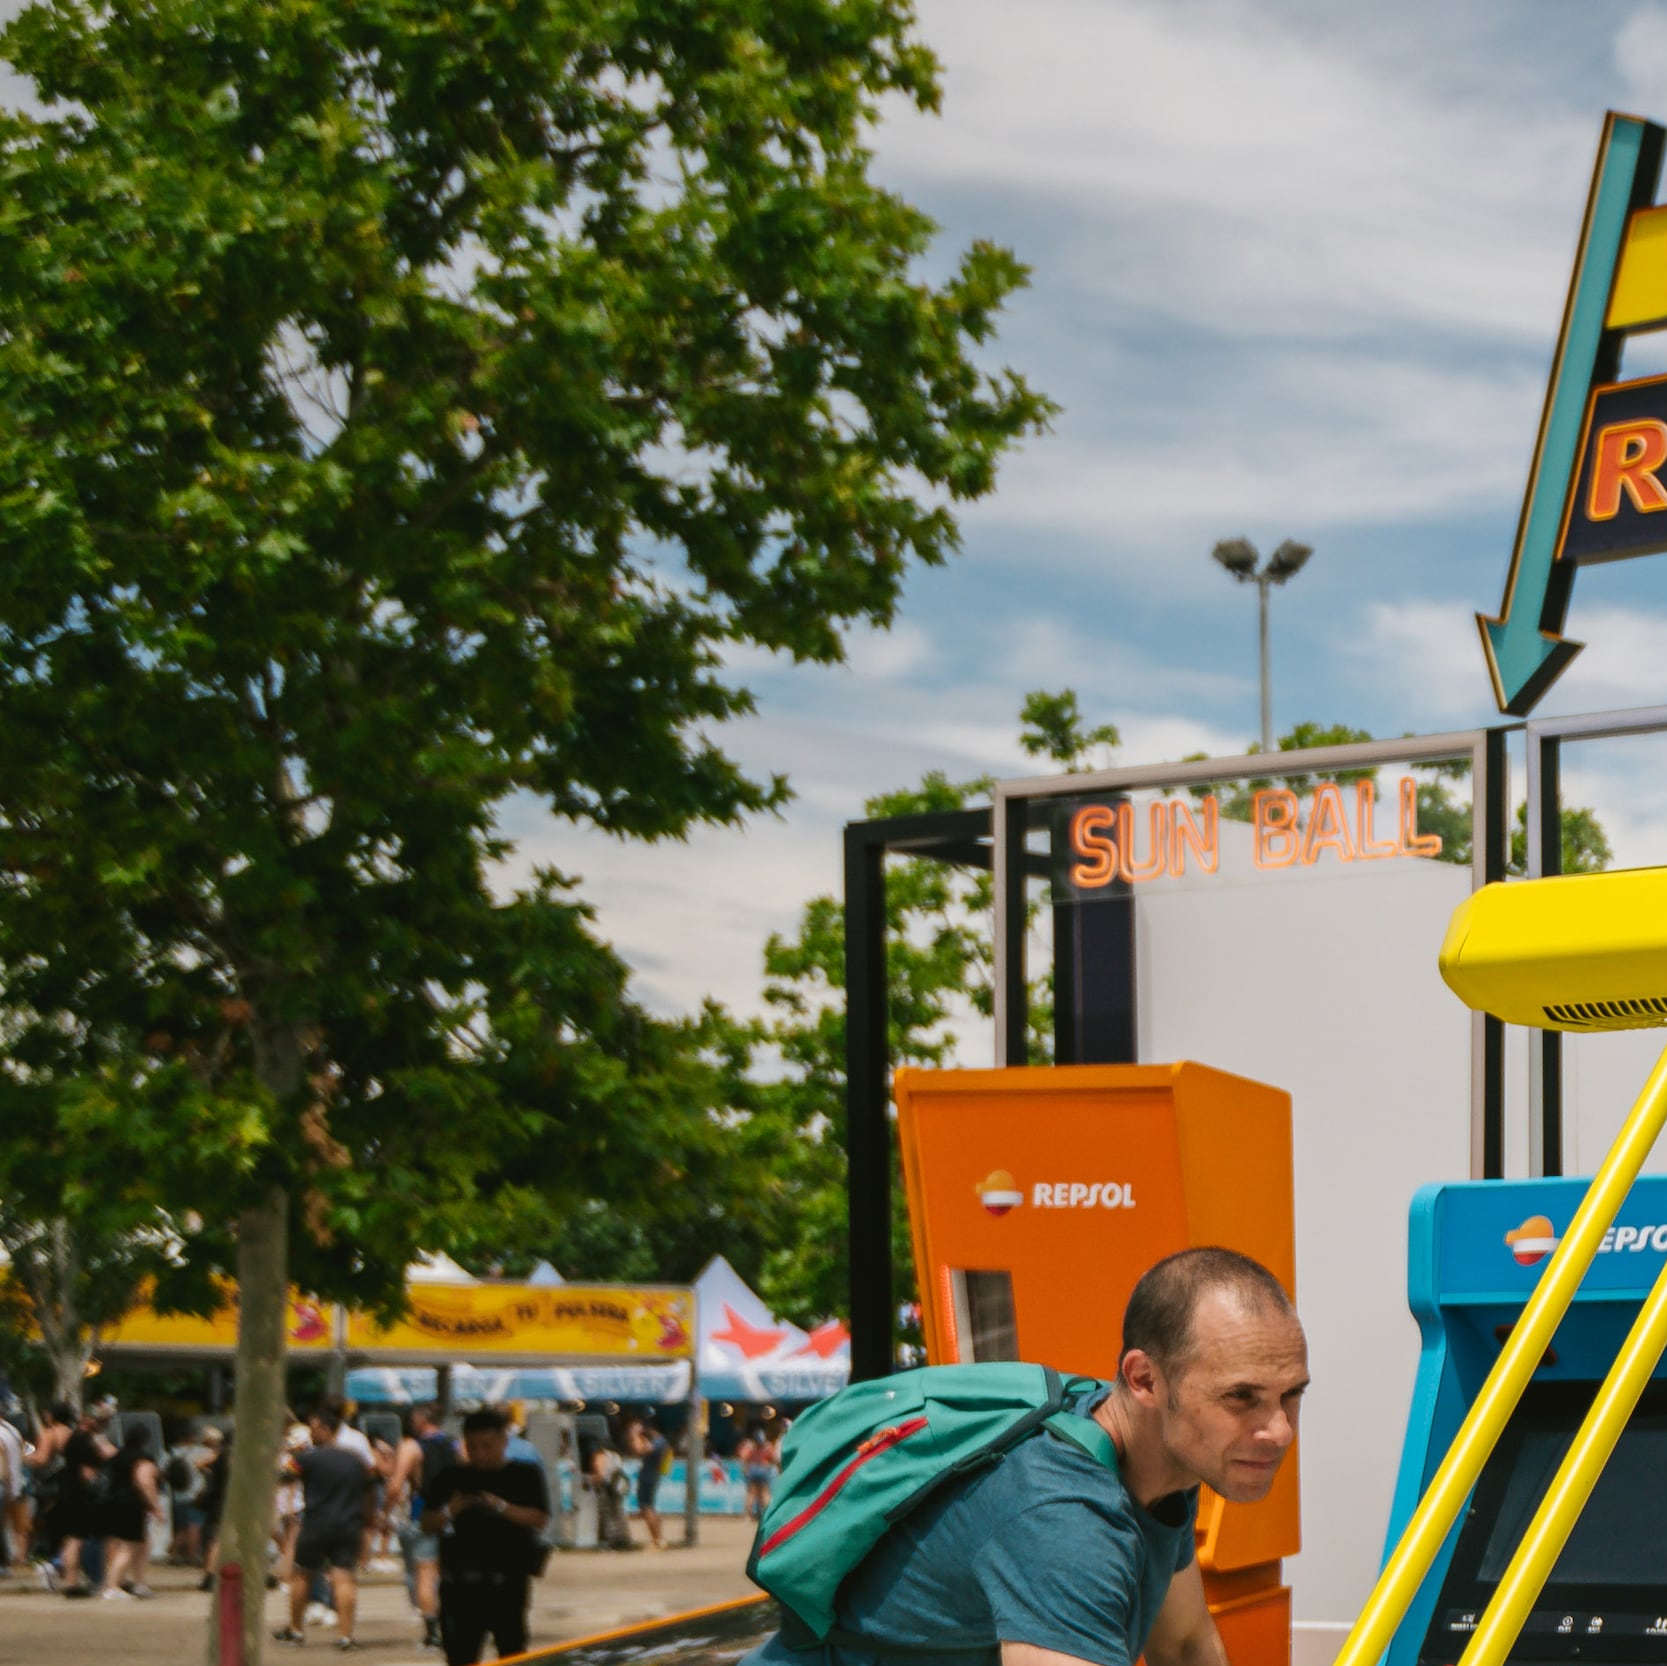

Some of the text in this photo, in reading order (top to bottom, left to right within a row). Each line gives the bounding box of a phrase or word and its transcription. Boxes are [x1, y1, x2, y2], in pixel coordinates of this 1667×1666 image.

[1070, 777, 1442, 889] SUN BALL
[1032, 1181, 1136, 1210] REPSOL
[584, 1373, 666, 1397] SILVER
[770, 1373, 845, 1397] SILVE
